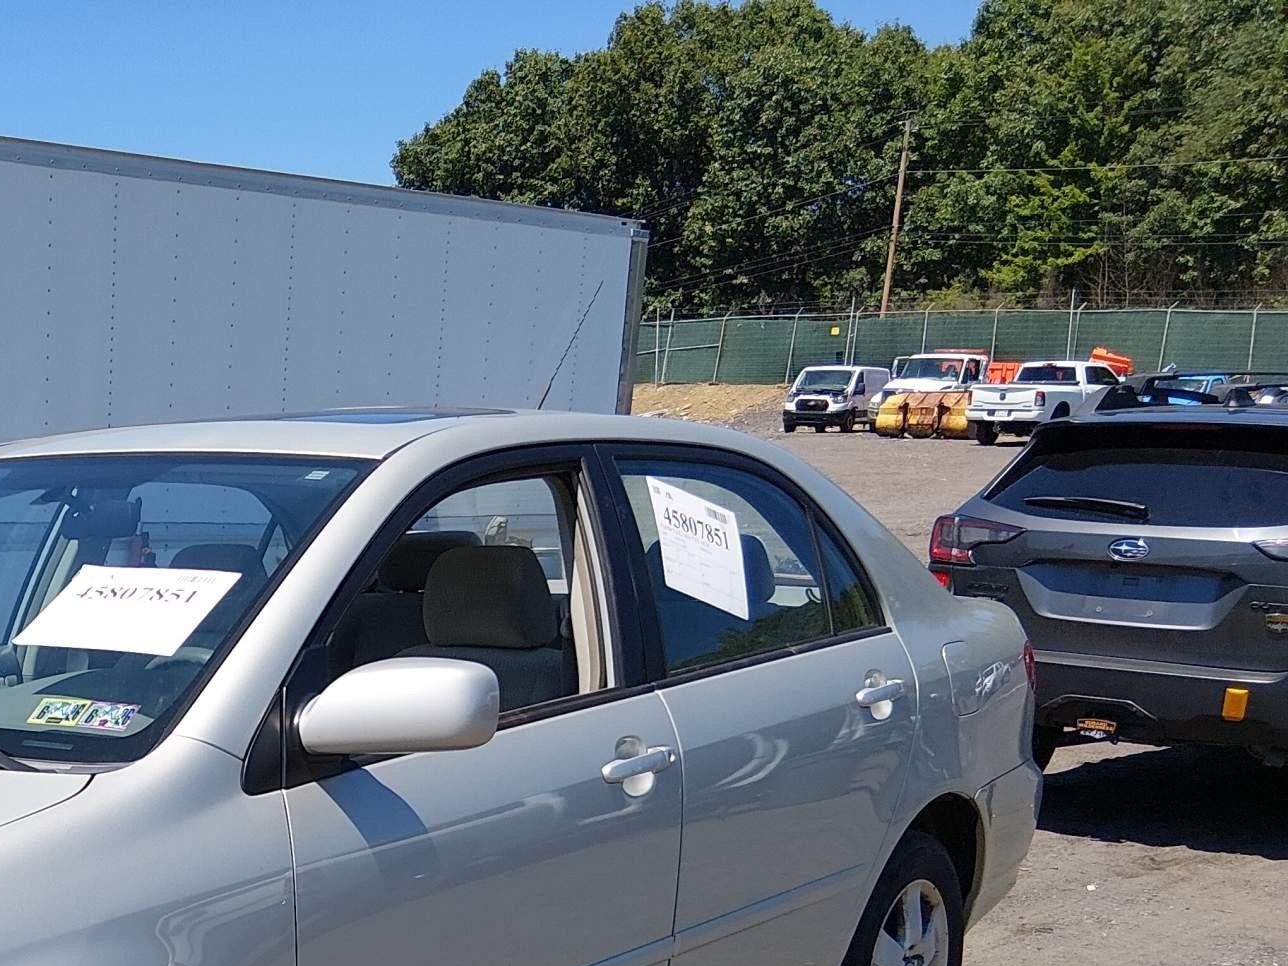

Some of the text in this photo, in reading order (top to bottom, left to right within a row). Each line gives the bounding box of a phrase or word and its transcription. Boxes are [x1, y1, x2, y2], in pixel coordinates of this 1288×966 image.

[663, 507, 729, 550] 45807851
[76, 586, 199, 603] 45807851
[37, 705, 50, 720] 6
[84, 709, 99, 724] 6
